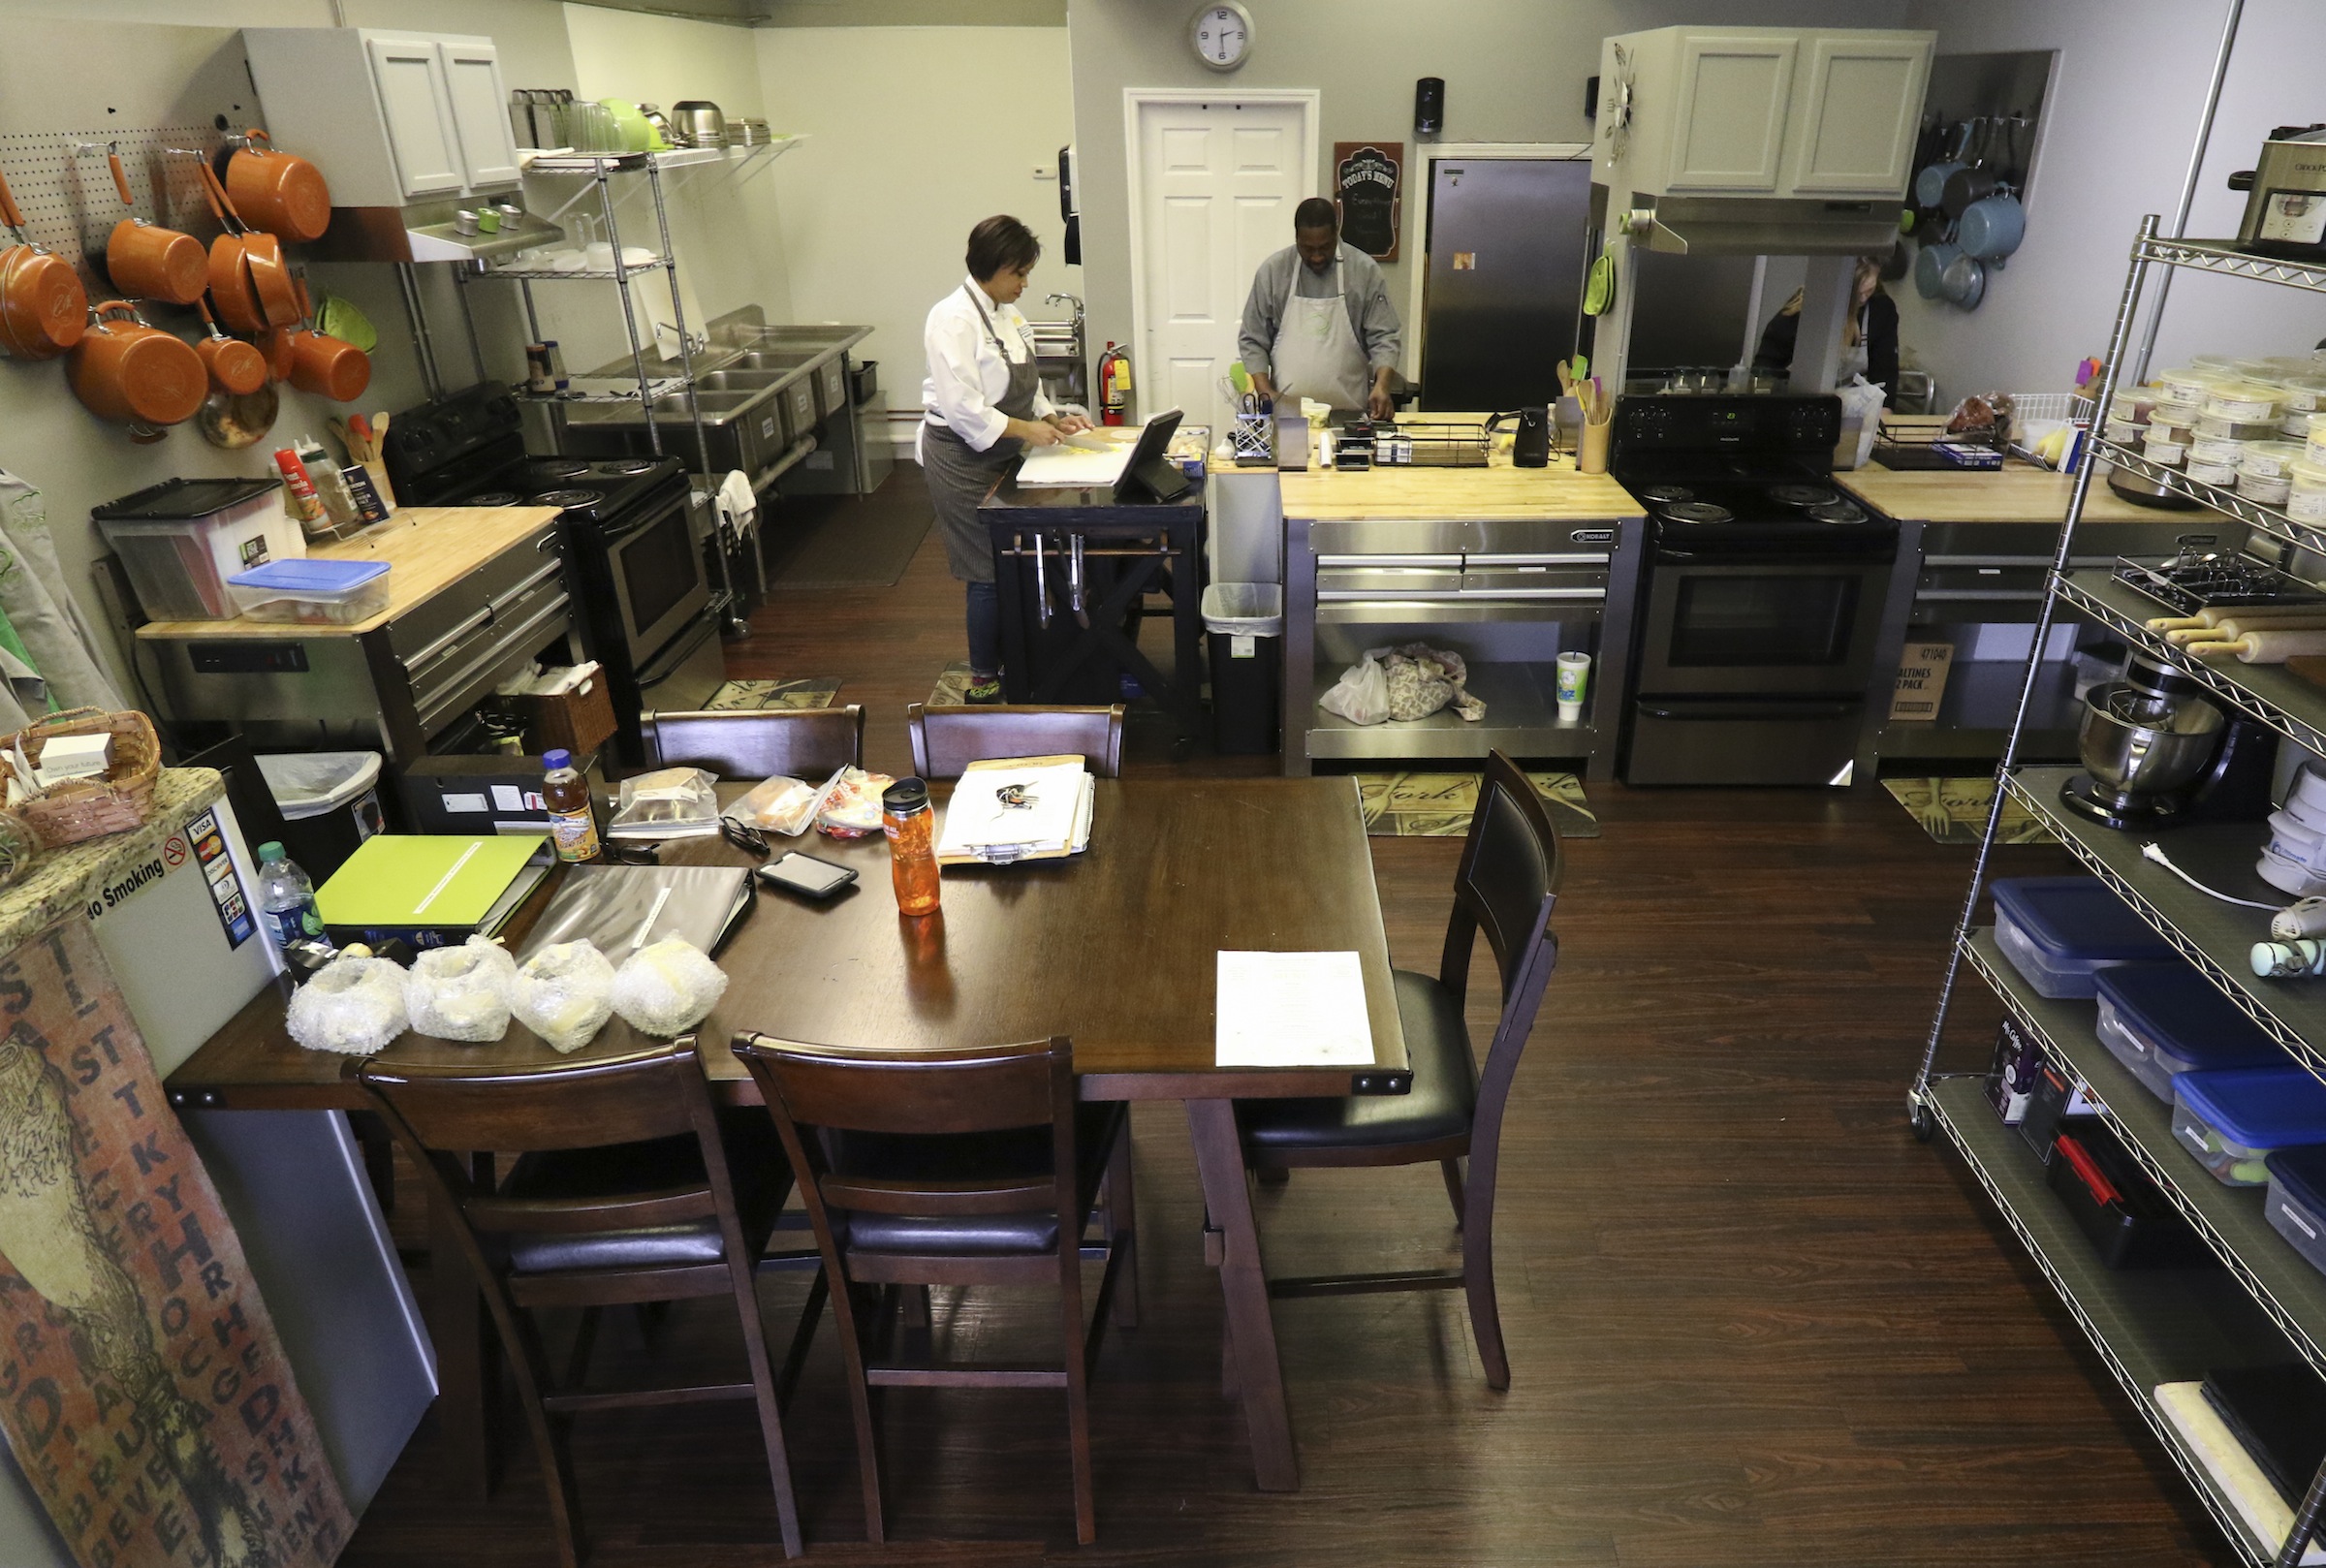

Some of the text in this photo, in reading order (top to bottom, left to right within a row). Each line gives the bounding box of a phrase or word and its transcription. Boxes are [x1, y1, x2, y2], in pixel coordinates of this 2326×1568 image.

[1217, 11, 1227, 19] 12
[1201, 31, 1209, 40] 9
[1237, 31, 1243, 40] 3
[1218, 51, 1226, 60] 6
[1372, 170, 1395, 189] MENU
[1902, 680, 1924, 690] PACK
[193, 819, 212, 835] VISA
[102, 857, 165, 908] Smoking
